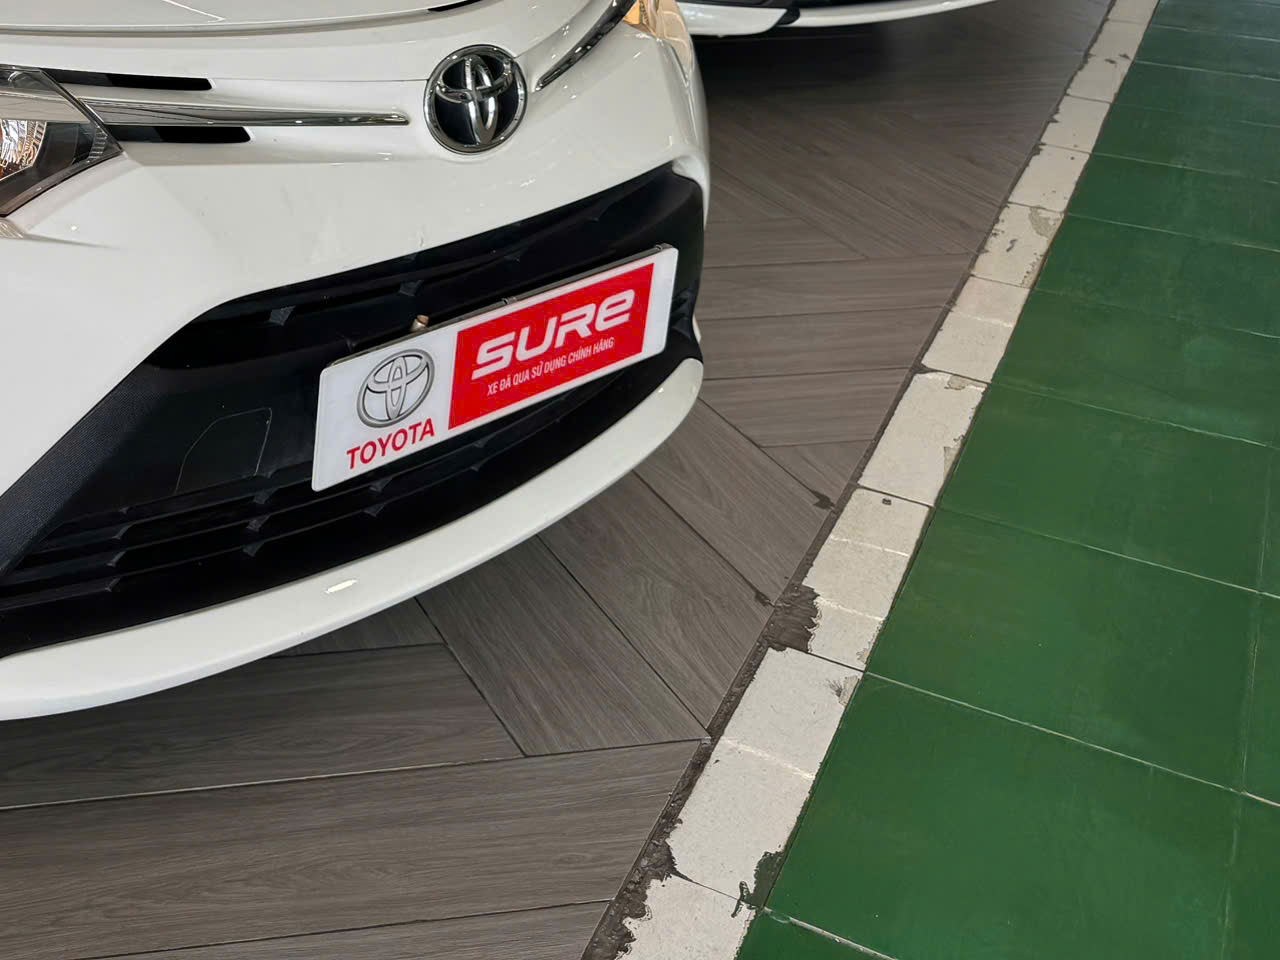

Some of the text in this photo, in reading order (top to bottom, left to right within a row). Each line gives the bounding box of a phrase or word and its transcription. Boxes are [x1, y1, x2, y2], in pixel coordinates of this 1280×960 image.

[487, 383, 499, 396] XE
[513, 371, 530, 387] QUA
[544, 355, 568, 373] DỤNG
[345, 417, 436, 470] TOYOTA
